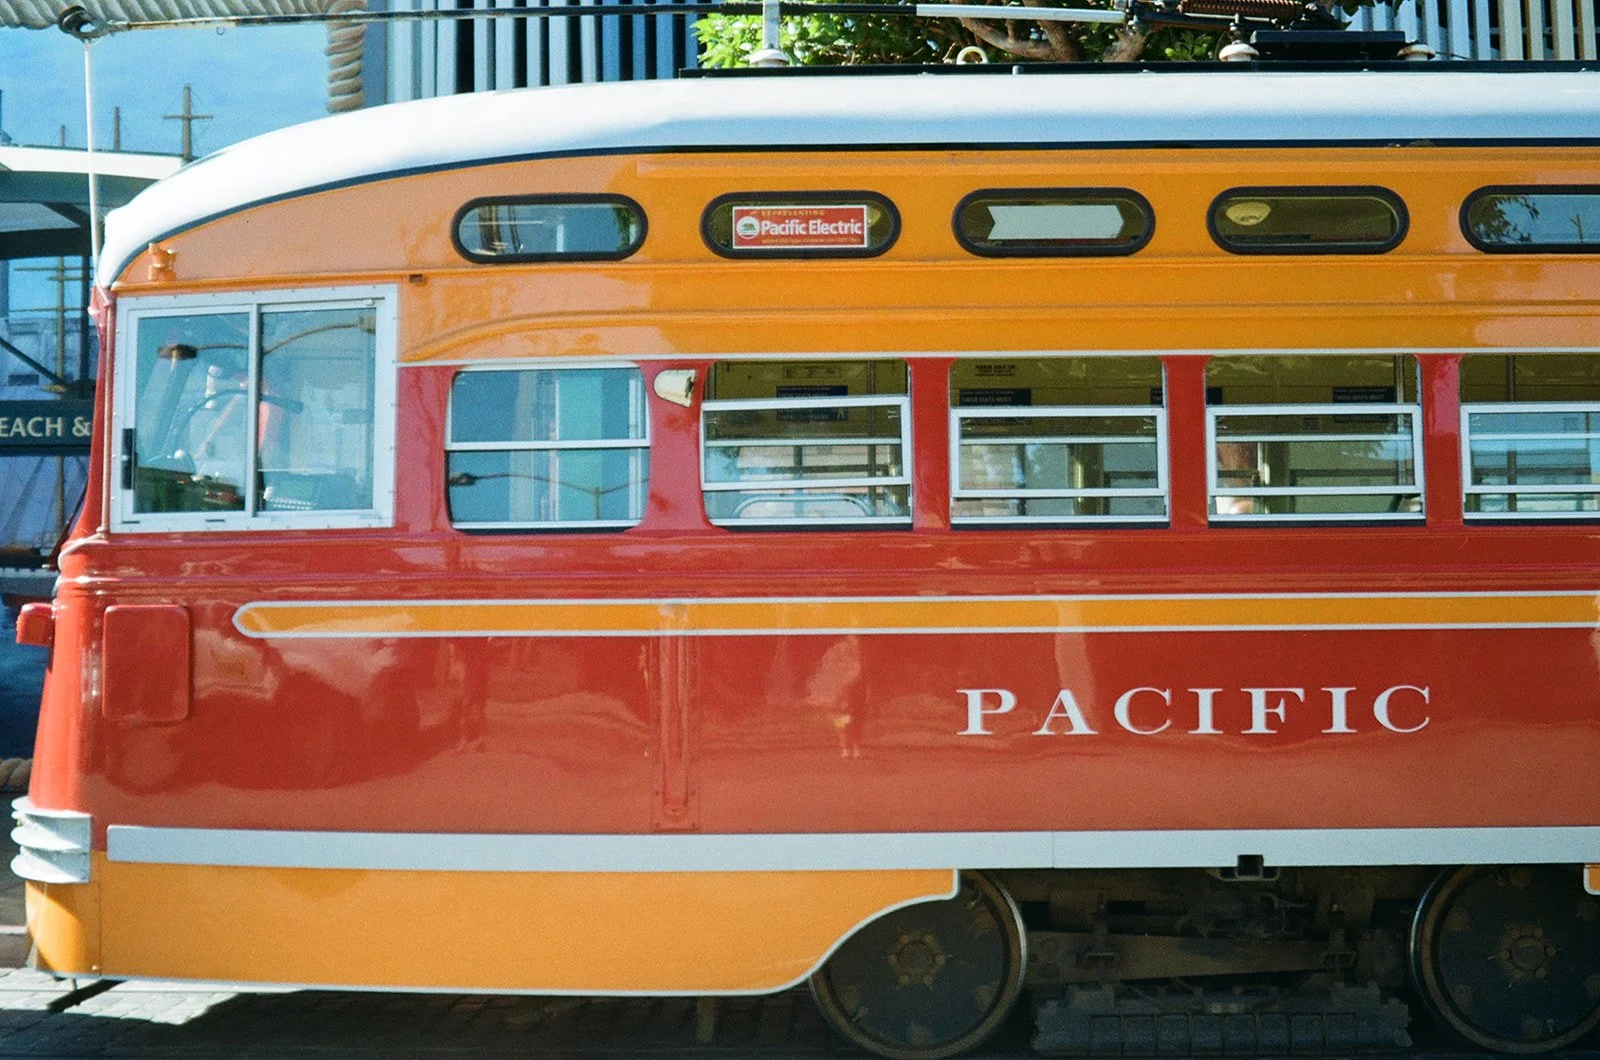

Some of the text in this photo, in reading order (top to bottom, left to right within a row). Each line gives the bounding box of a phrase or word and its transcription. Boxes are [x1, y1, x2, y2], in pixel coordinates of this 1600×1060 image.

[761, 219, 862, 236] Pacific Electric
[72, 416, 92, 437] &
[956, 685, 1430, 735] PACIFIC
